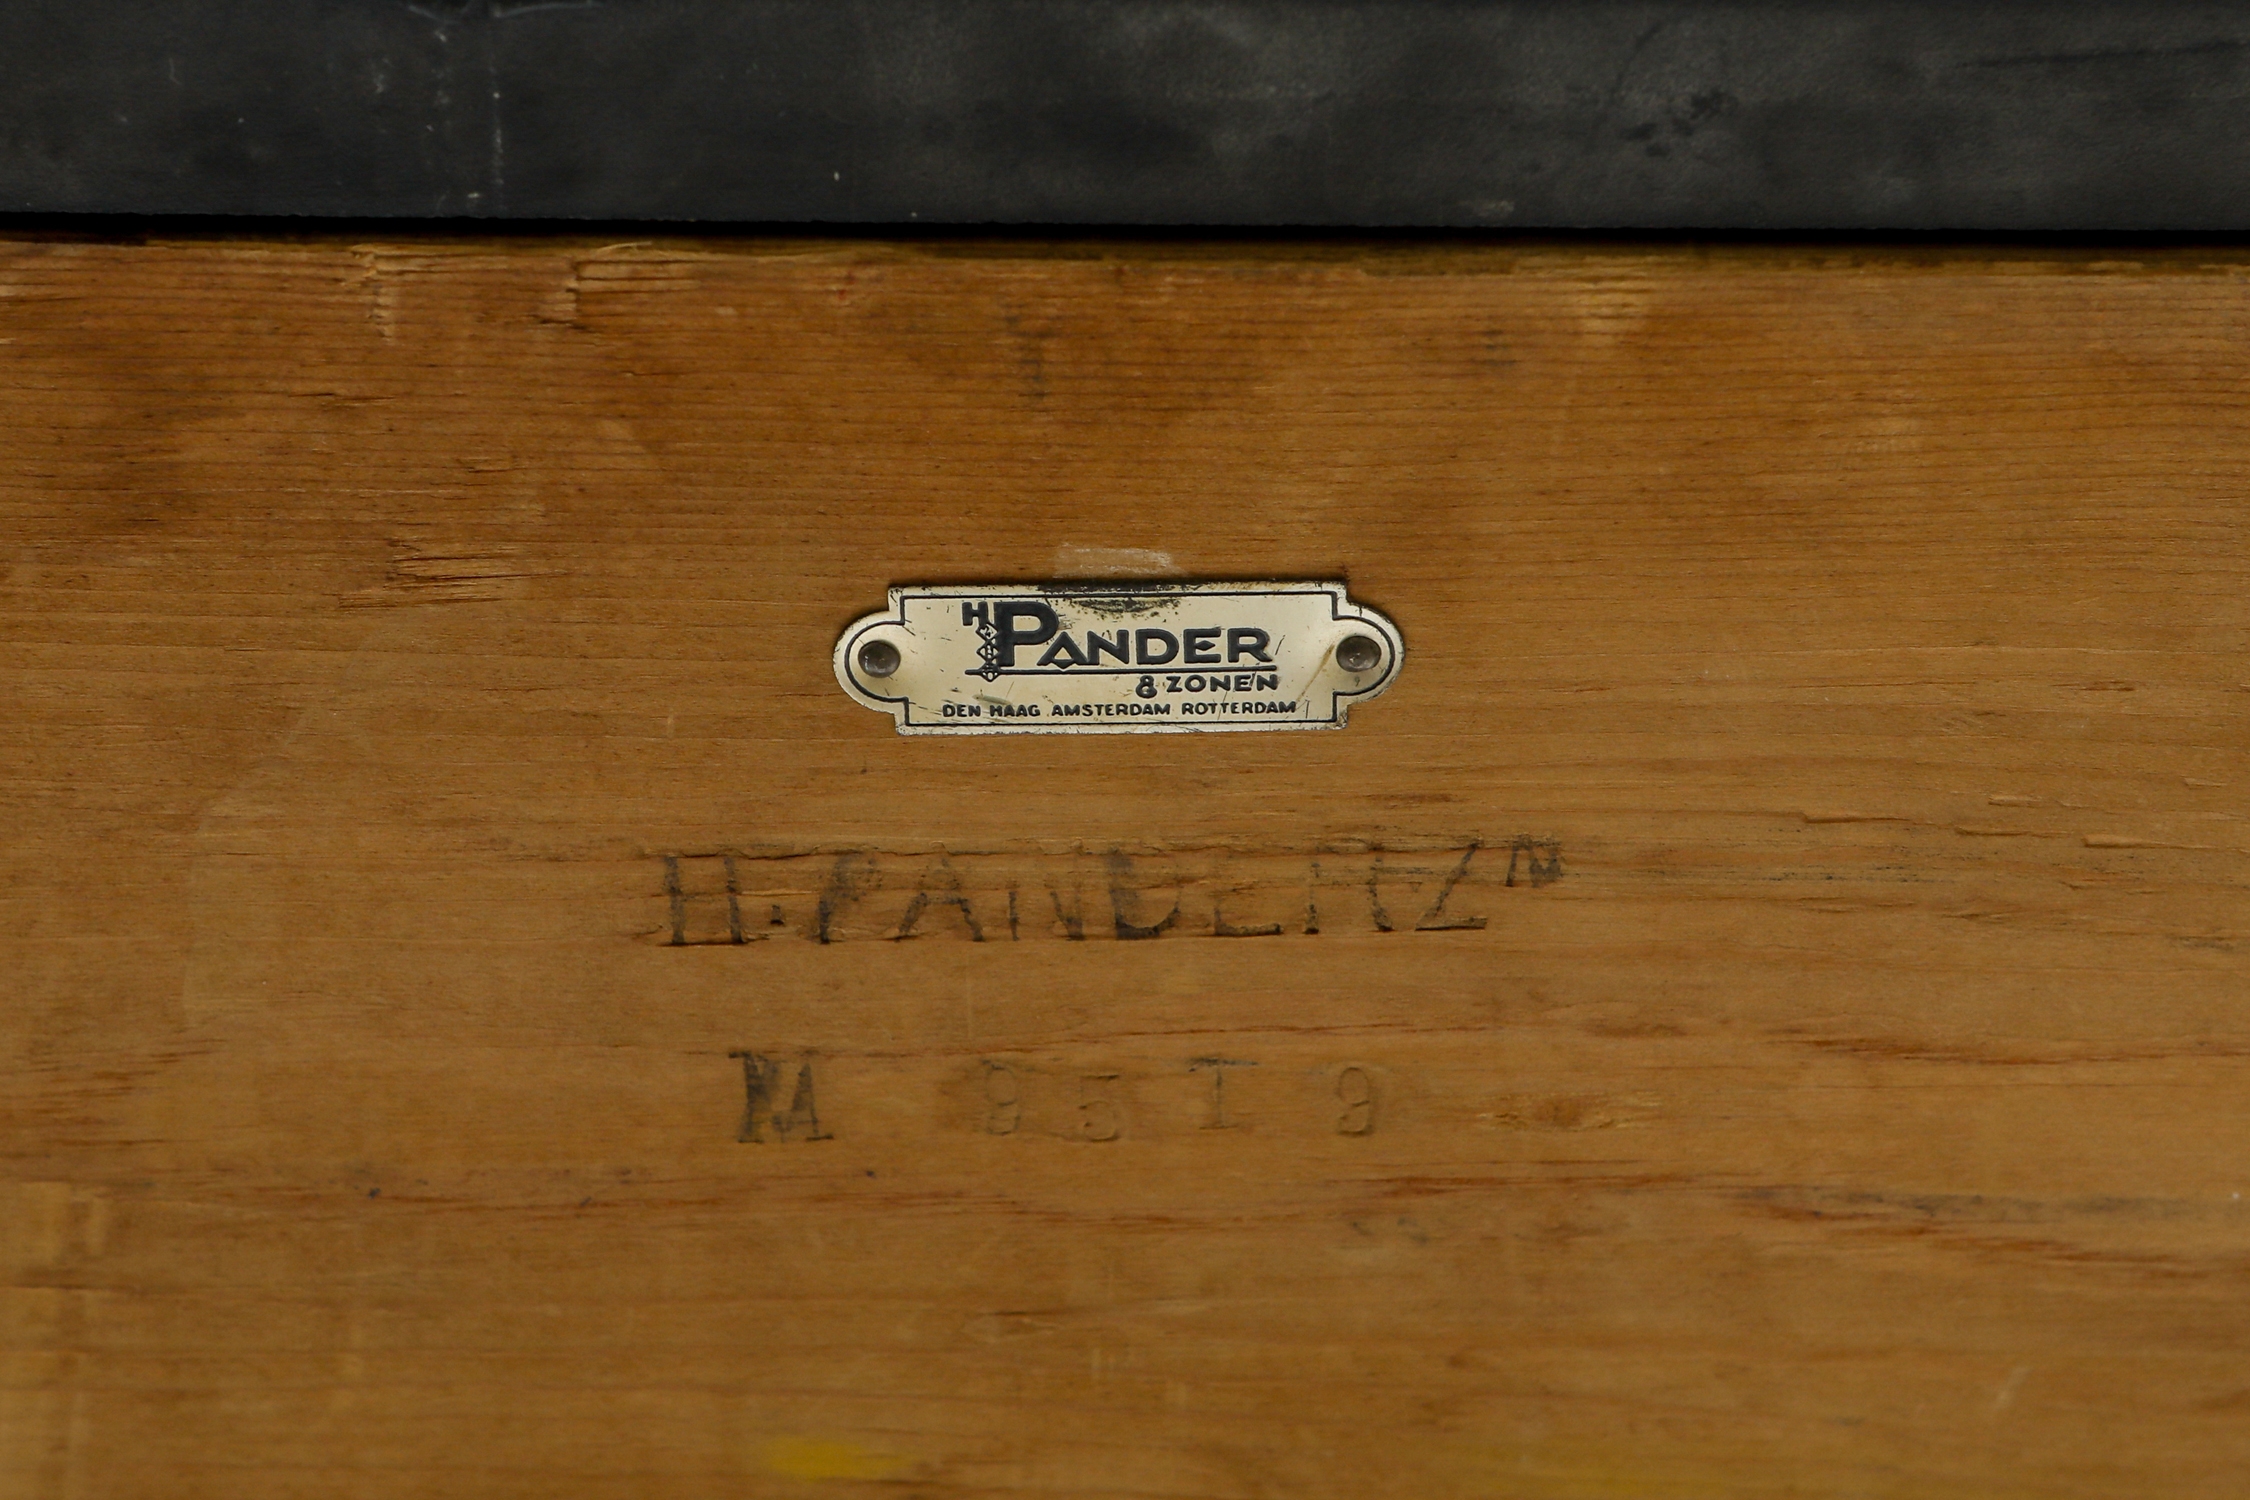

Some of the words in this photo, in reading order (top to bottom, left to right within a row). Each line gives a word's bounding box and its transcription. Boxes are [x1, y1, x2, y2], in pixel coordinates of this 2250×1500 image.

[961, 600, 989, 627] H
[993, 600, 1274, 670] PANDER
[1165, 673, 1279, 693] ZONEN
[942, 703, 982, 718] DEN
[989, 703, 1041, 718] HAAG
[1051, 702, 1171, 717] AMSTERDAM
[1181, 700, 1297, 716] ROTTERDAM
